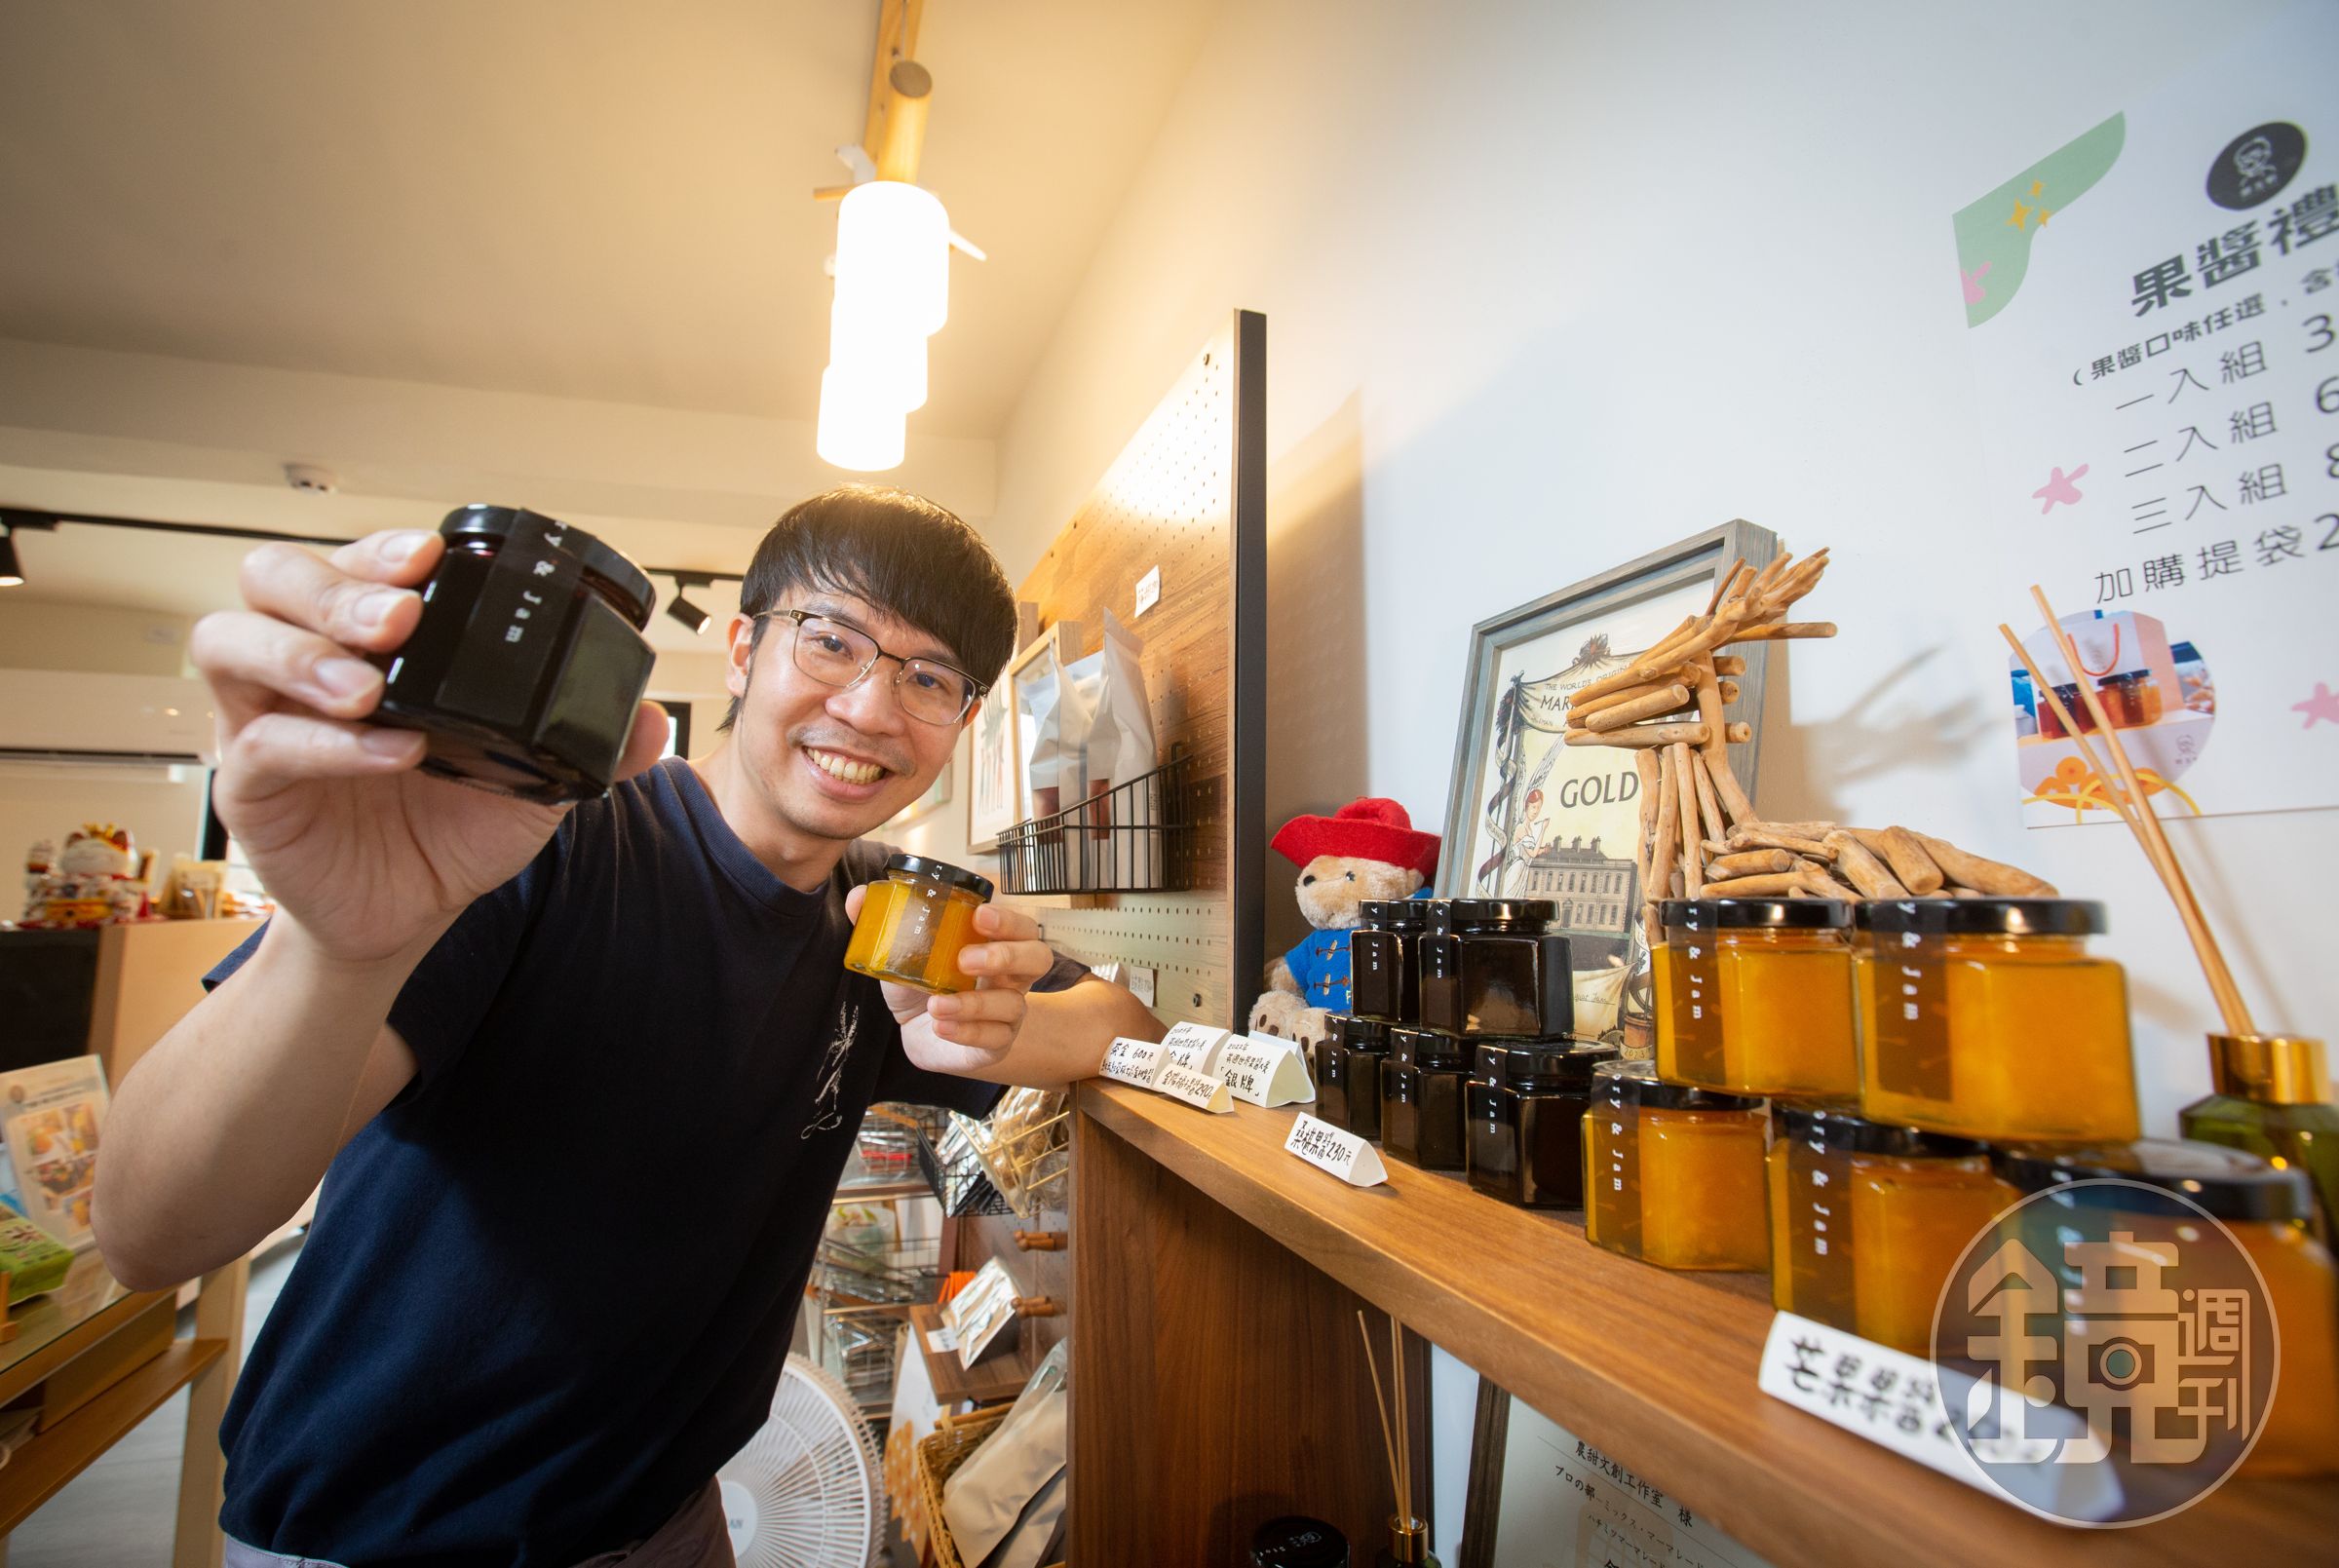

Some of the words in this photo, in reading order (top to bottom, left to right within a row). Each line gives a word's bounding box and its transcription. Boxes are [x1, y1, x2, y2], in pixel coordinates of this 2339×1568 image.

[2130, 183, 2339, 318] 果醬禮
[2115, 340, 2269, 410] 一入組
[2124, 402, 2279, 478] 二入組
[2131, 463, 2289, 535] 三入組
[1540, 695, 1575, 711] MAR
[1559, 771, 1639, 809] GOLD
[914, 904, 931, 935] Jam
[1690, 975, 1704, 1020] Jam
[1901, 966, 1923, 1021] Jam
[1612, 1148, 1625, 1193] Jam
[1813, 1202, 1831, 1257] Jam
[1575, 1440, 1665, 1510] 農甜文創工作室
